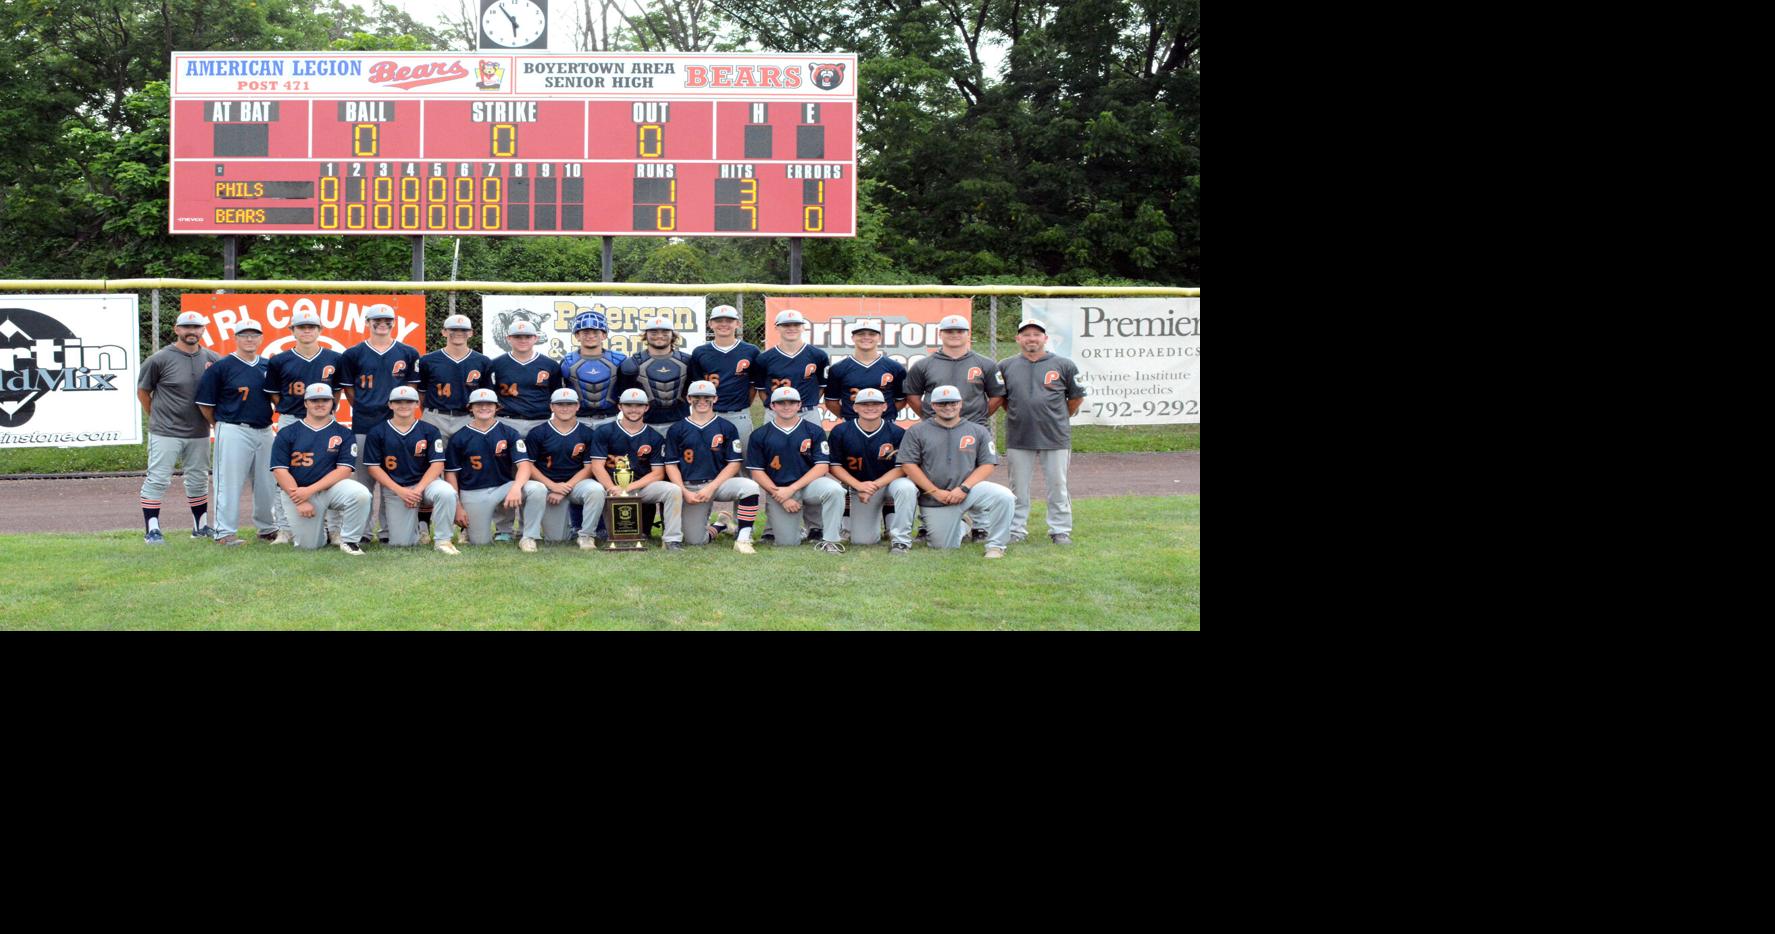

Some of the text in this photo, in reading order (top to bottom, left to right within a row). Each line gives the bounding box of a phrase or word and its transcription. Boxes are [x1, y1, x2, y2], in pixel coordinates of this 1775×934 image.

[186, 60, 362, 76] AMERICAN LEGION
[368, 60, 469, 90] Bears
[524, 62, 676, 74] BOYERTOWN AREA
[545, 76, 654, 88] SENIOR HIGH
[684, 64, 802, 88] BEARS
[238, 81, 309, 90] POST 471
[213, 102, 270, 122] AT BAT
[346, 102, 386, 122] BALL
[472, 102, 536, 122] STRIKE
[633, 102, 668, 122] OUT
[754, 104, 764, 122] H
[807, 104, 814, 122] E
[354, 124, 376, 156] 0
[493, 124, 516, 156] 0
[640, 125, 662, 158] 0
[326, 164, 581, 177] 1 2 3 4 5 6 7 8 9 10
[636, 164, 841, 178] RUNS HITS ERRORS
[215, 182, 264, 197] PHILS
[320, 177, 338, 202] 0
[374, 177, 392, 202] 0
[402, 177, 420, 202] 0
[428, 177, 446, 202] 0
[456, 177, 473, 202] 0
[482, 177, 500, 202] 0
[740, 179, 756, 204] 3
[215, 204, 822, 231] BEARS 0 0 0 0 0 0 0 0 7 0
[1080, 306, 1200, 338] Premier
[1081, 347, 1200, 358] ORTHOPAEDICS
[322, 365, 335, 379] P
[392, 360, 406, 374] P
[736, 359, 750, 373] P
[805, 363, 817, 378] P
[466, 369, 481, 383] P
[537, 370, 550, 384] P
[880, 373, 894, 387] P
[968, 367, 982, 380] P
[1044, 371, 1060, 385] P
[1136, 370, 1191, 381] Institute
[288, 381, 305, 395] 18
[360, 374, 374, 389] 11
[238, 386, 249, 400] 7
[436, 383, 451, 398] 14
[500, 383, 518, 397] 24
[1073, 399, 1200, 418] -792-9292
[328, 435, 342, 449] P
[415, 440, 427, 454] P
[495, 440, 507, 453] P
[711, 434, 723, 447] P
[800, 439, 812, 452] P
[960, 435, 975, 448] P
[571, 443, 586, 457] P
[637, 444, 652, 456] P
[684, 448, 694, 463] 8
[879, 443, 894, 457] P
[290, 451, 314, 467] 25
[385, 456, 397, 470] 6
[470, 456, 482, 470] 5
[770, 455, 781, 470] 4
[848, 457, 862, 471] 21
